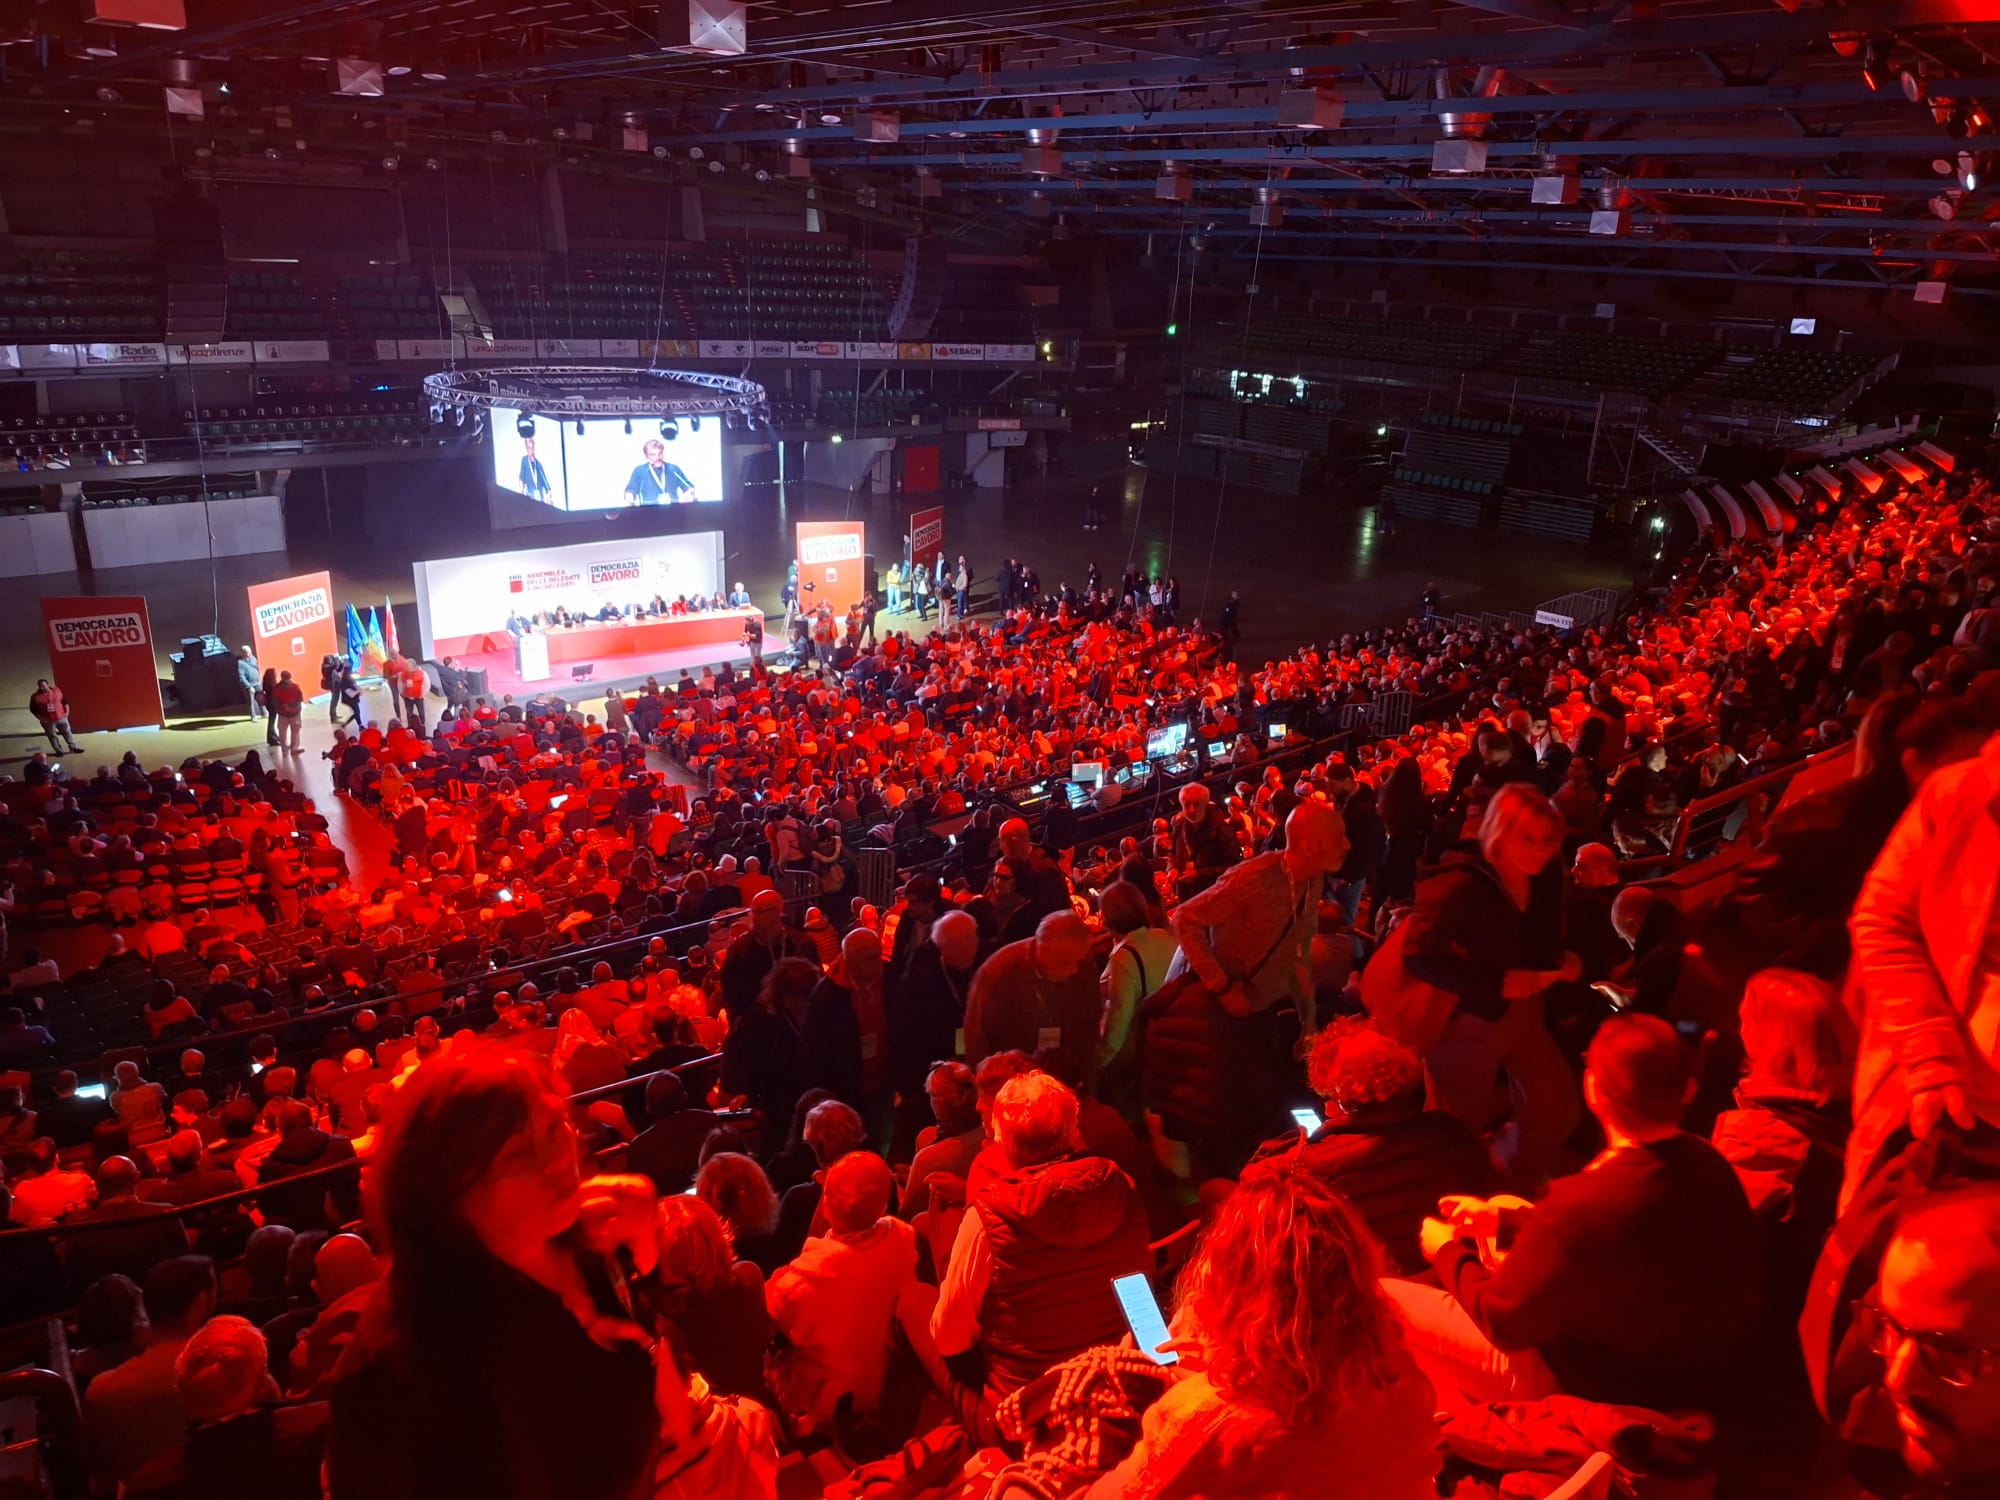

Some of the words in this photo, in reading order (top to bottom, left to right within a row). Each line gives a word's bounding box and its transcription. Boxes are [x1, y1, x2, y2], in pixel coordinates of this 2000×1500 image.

[120, 345, 157, 356] Radio
[949, 348, 981, 356] SEBACH
[590, 561, 639, 573] DEMOCRAZIA
[591, 568, 640, 584] LAVORO
[260, 593, 323, 619] DEMOCRAZIA
[54, 617, 137, 633] DEMOCRAZIA
[262, 603, 325, 633] LAVORO
[60, 627, 140, 649] LAVORO
